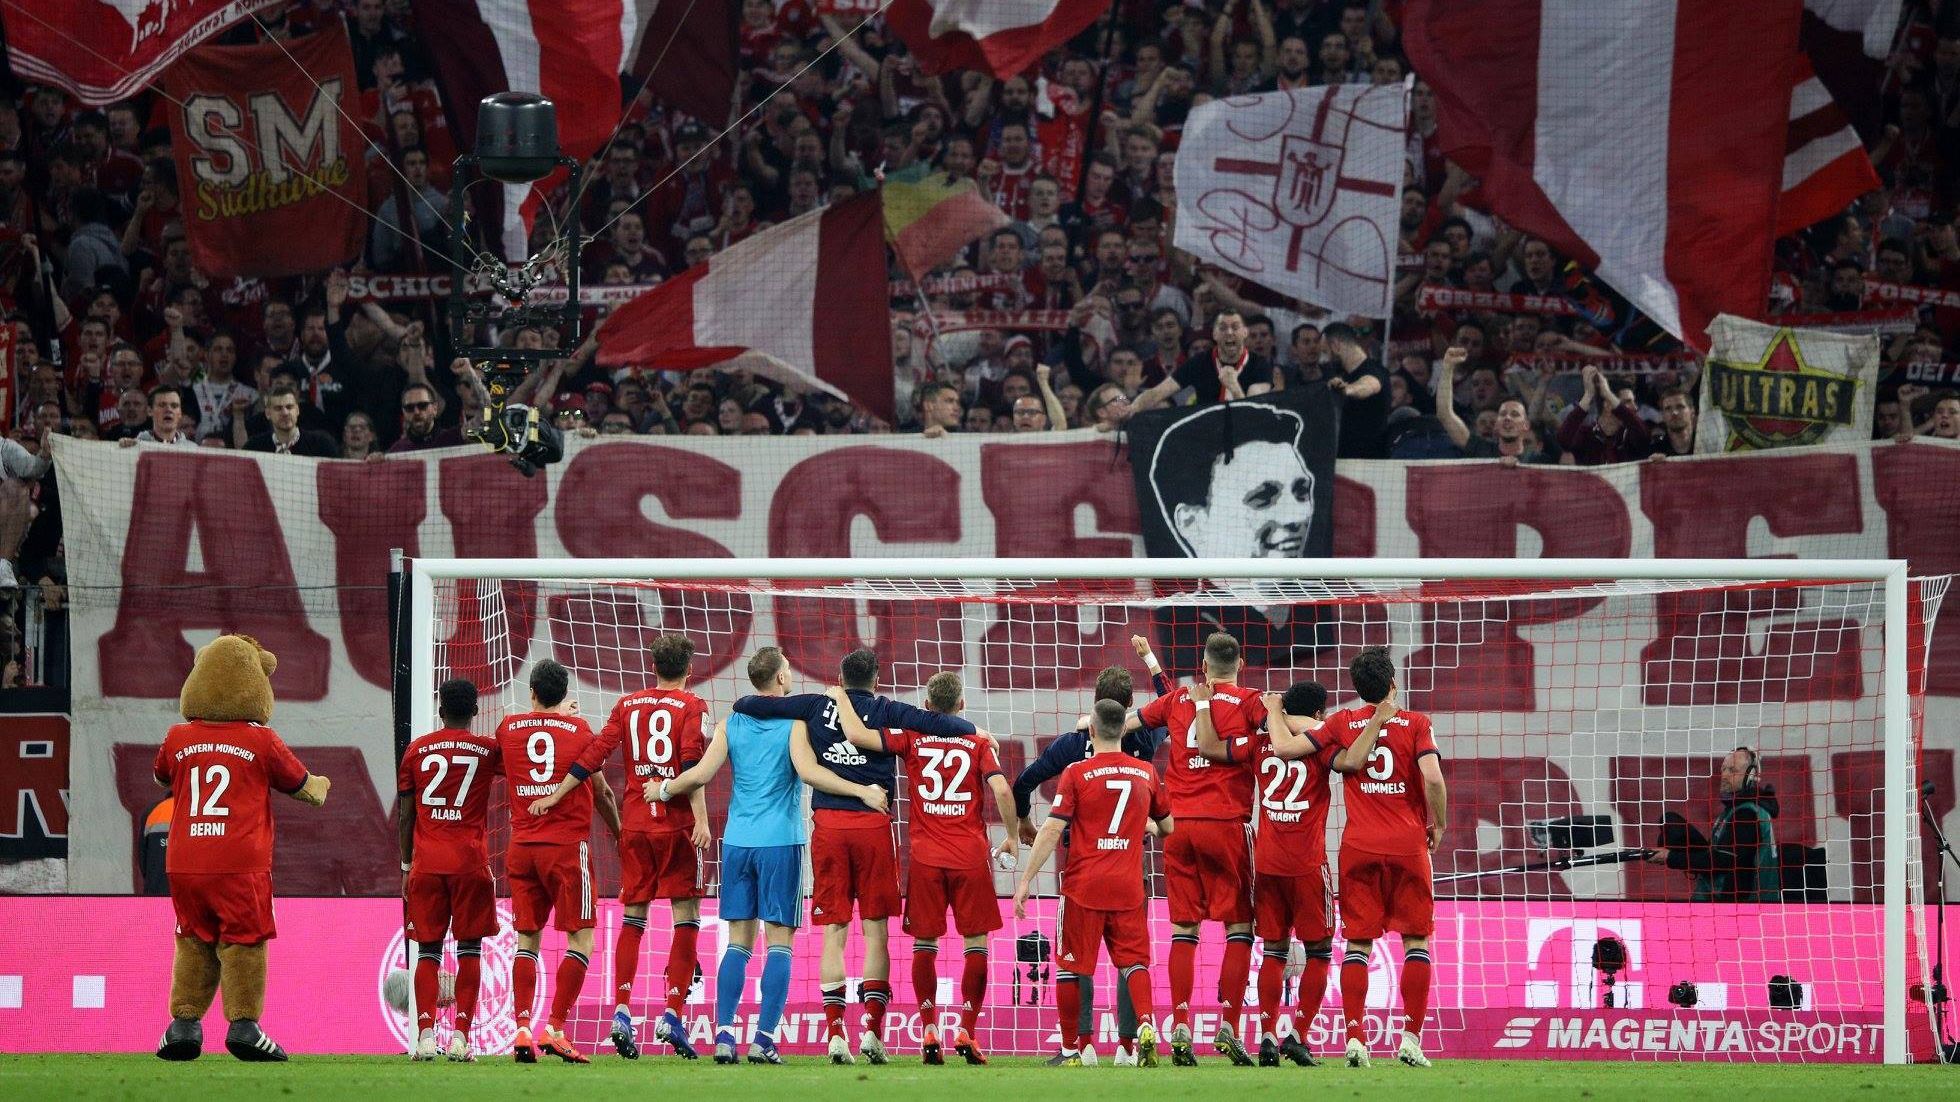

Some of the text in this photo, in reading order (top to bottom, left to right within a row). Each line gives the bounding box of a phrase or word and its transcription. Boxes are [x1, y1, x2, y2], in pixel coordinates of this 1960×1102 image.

[184, 76, 343, 188] SM
[1720, 372, 1840, 418] ULTRAS
[97, 441, 1960, 714] AUSGEPE
[508, 723, 516, 731] FC
[516, 718, 542, 729] BAYERN
[629, 709, 673, 764] 18
[175, 752, 184, 763] FC
[183, 743, 214, 755] BAYERN
[418, 746, 428, 754] FC
[428, 741, 455, 751] BAYERN
[526, 731, 555, 783] 9
[822, 752, 868, 766] adidas
[1366, 728, 1394, 781] 5
[190, 764, 231, 817] 12
[421, 753, 479, 807] 27
[516, 783, 562, 797] LEWANDOW
[917, 747, 972, 802] 32
[1083, 771, 1094, 781] FC
[1093, 766, 1119, 777] BAYERN
[1261, 756, 1310, 811] 22
[1360, 782, 1406, 795] HUMMELS
[430, 808, 462, 821] ALABA
[922, 801, 966, 816] KIMMICH
[1105, 780, 1132, 834] 7
[190, 822, 225, 837] BERNI
[1097, 836, 1130, 850] RIBÉRY
[1546, 1016, 1886, 1056] MAGENTA SPORT
